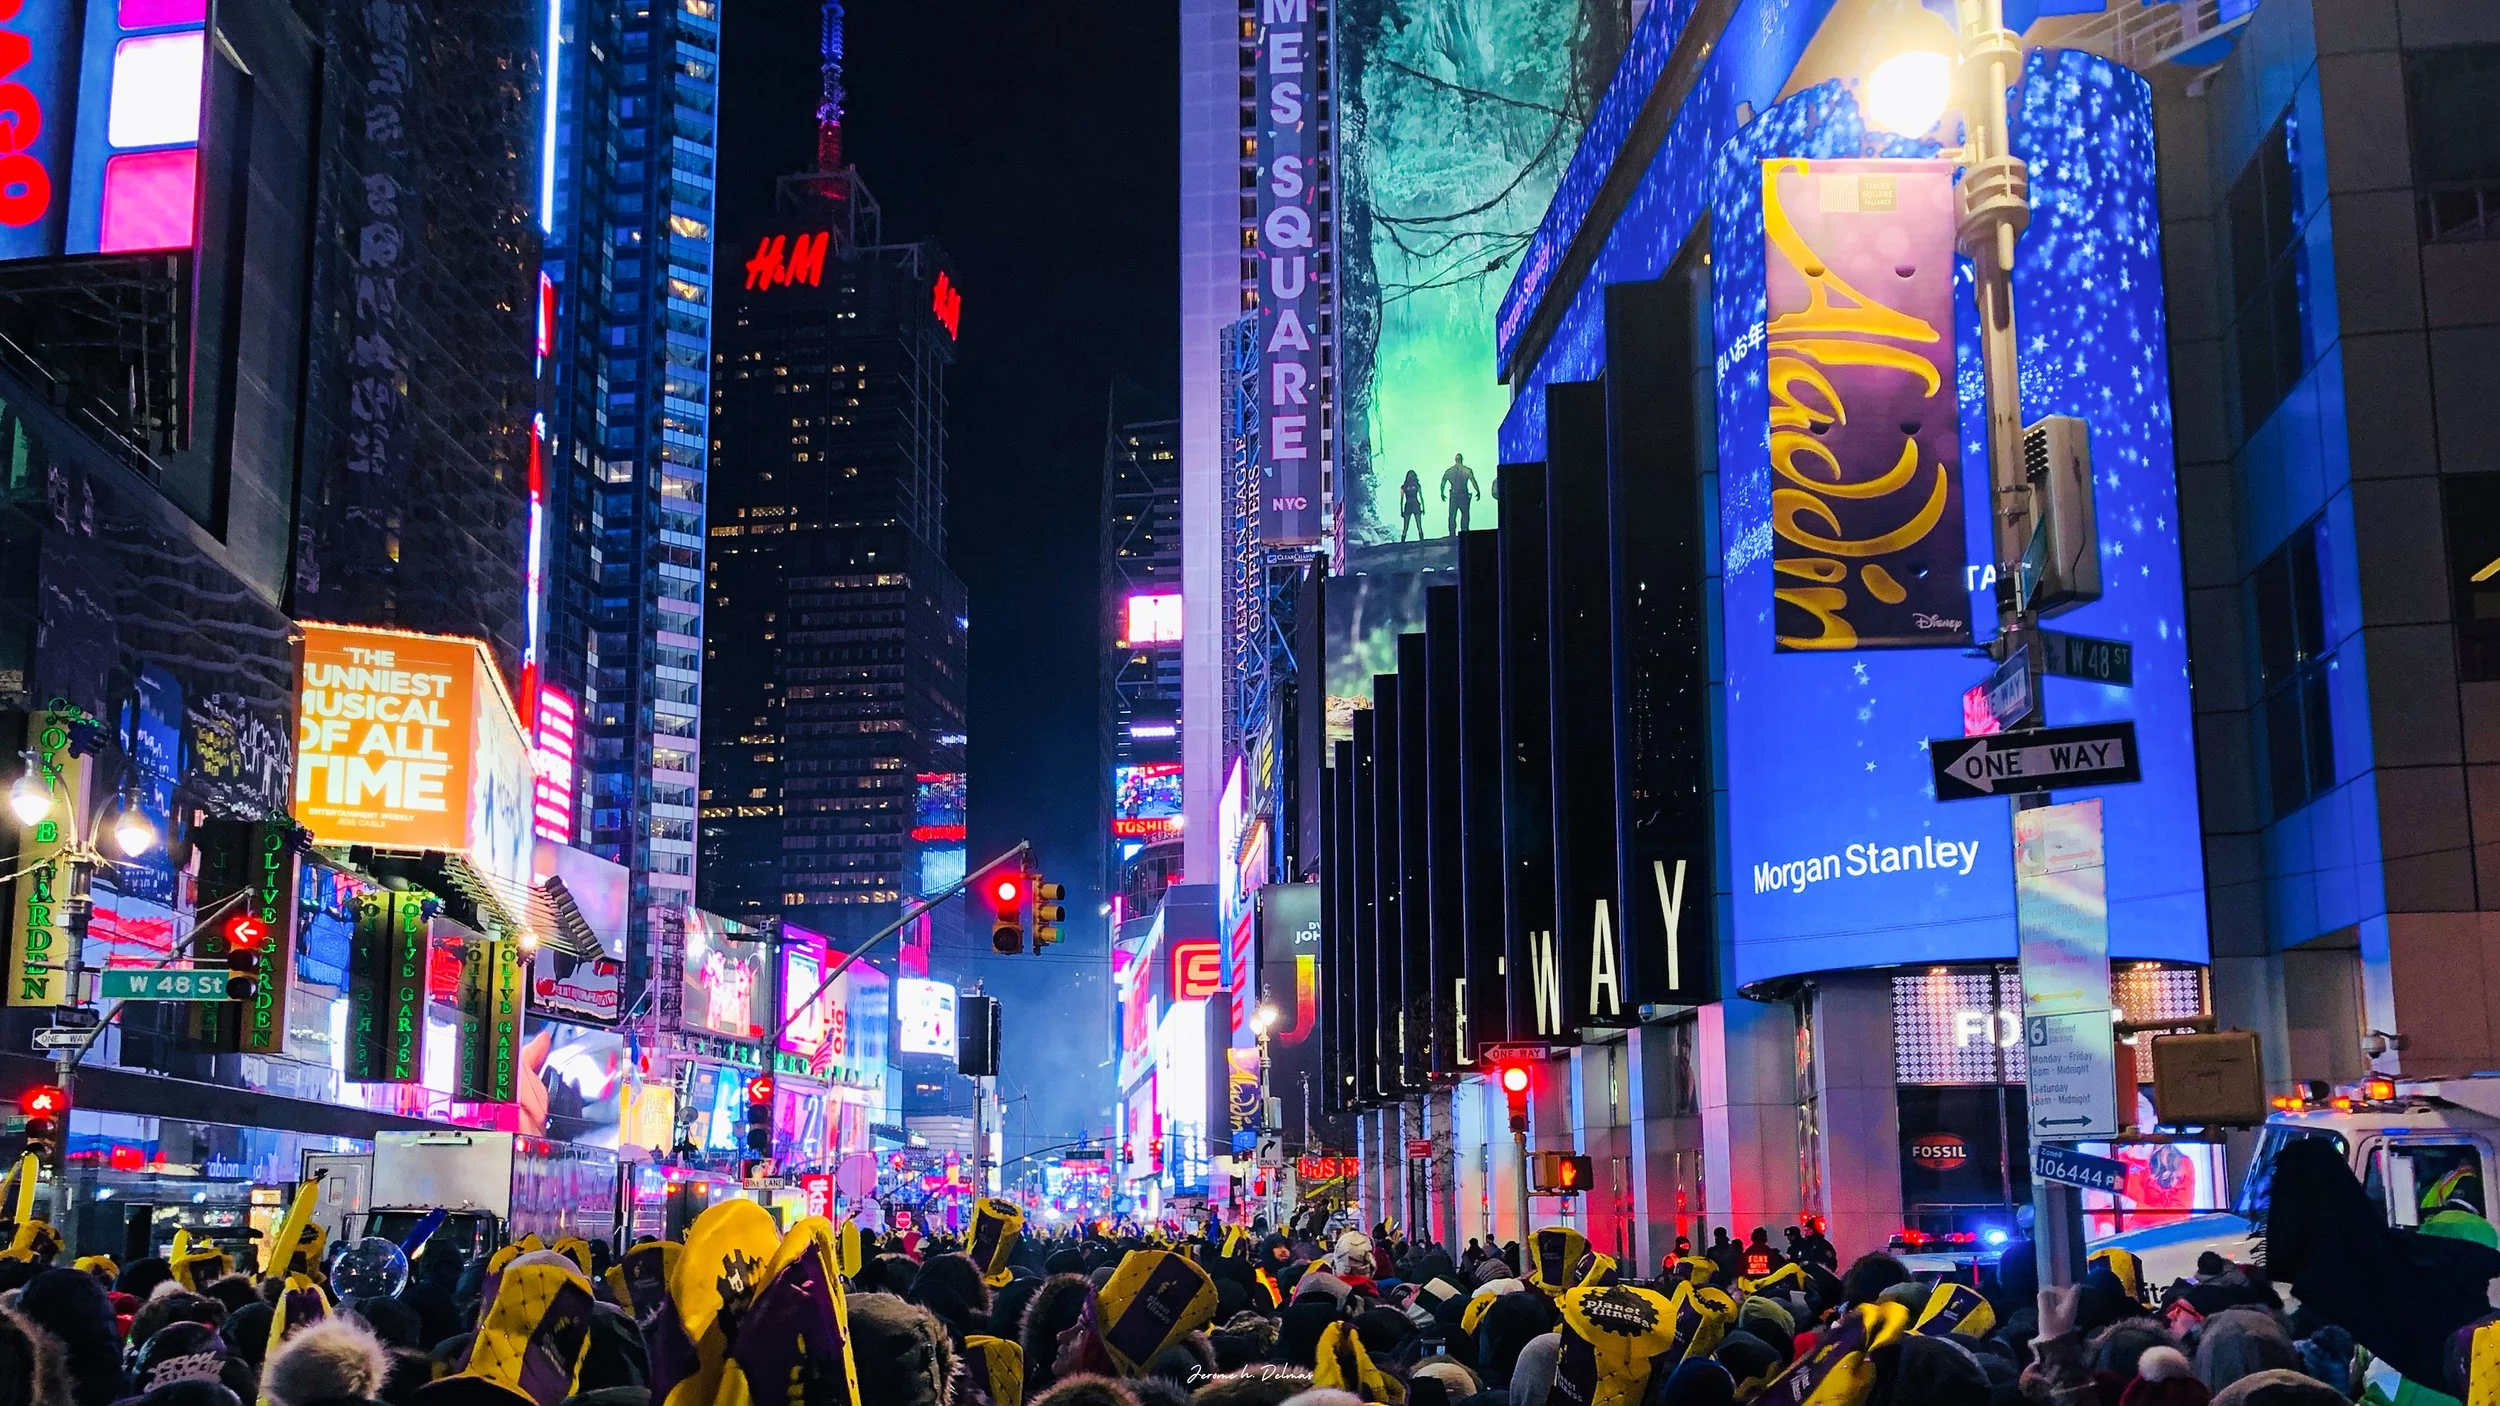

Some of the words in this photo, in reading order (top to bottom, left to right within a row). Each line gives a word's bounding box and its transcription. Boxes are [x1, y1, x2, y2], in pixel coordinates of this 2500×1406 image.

[745, 231, 829, 291] H&M
[1265, 156, 1313, 460] SQUARE
[1235, 434, 1248, 517] EAGLE
[1272, 497, 1307, 511] NYC
[1248, 465, 1261, 633] OUTFITTERS
[1235, 528, 1248, 673] AMERICAN
[2071, 643, 2084, 674] W
[2088, 646, 2110, 679] 48
[2114, 647, 2129, 665] ST
[359, 723, 448, 760] ALL
[1965, 752, 2023, 779] ONE
[2050, 743, 2111, 771] WAY
[37, 727, 67, 843] OLIE
[308, 808, 379, 821] ENTERTAINMENT
[1116, 821, 1175, 833] TOSHIB
[263, 834, 283, 924] OLIVE
[1753, 854, 1841, 894] Morgan
[1845, 835, 1979, 875] Stanley
[402, 902, 420, 978] OLIVE
[129, 975, 148, 993] W
[156, 976, 190, 994] 48
[198, 976, 223, 994] St
[252, 936, 277, 1047] GARDEN
[499, 949, 515, 1015] OLIVE
[41, 1034, 59, 1044] ONE
[394, 986, 414, 1079] GARDEN
[2029, 1017, 2045, 1045] 6
[495, 1021, 512, 1100] GARDEN
[1493, 1049, 1512, 1060] ONE
[1515, 1047, 1540, 1059] WAY
[2032, 1053, 2062, 1064] Monday
[2069, 1051, 2093, 1062] Friday
[2057, 1064, 2090, 1076] Midnight
[2034, 1083, 2069, 1094] Saturday
[2058, 1093, 2091, 1106] Midnight
[1260, 1159, 1279, 1167] ONLY
[1912, 1145, 1967, 1158] FOSSIL
[764, 1179, 783, 1187] LANE
[2039, 1157, 2102, 1186] 106444
[1585, 1299, 1641, 1316] planet
[1592, 1307, 1651, 1329] fitness
